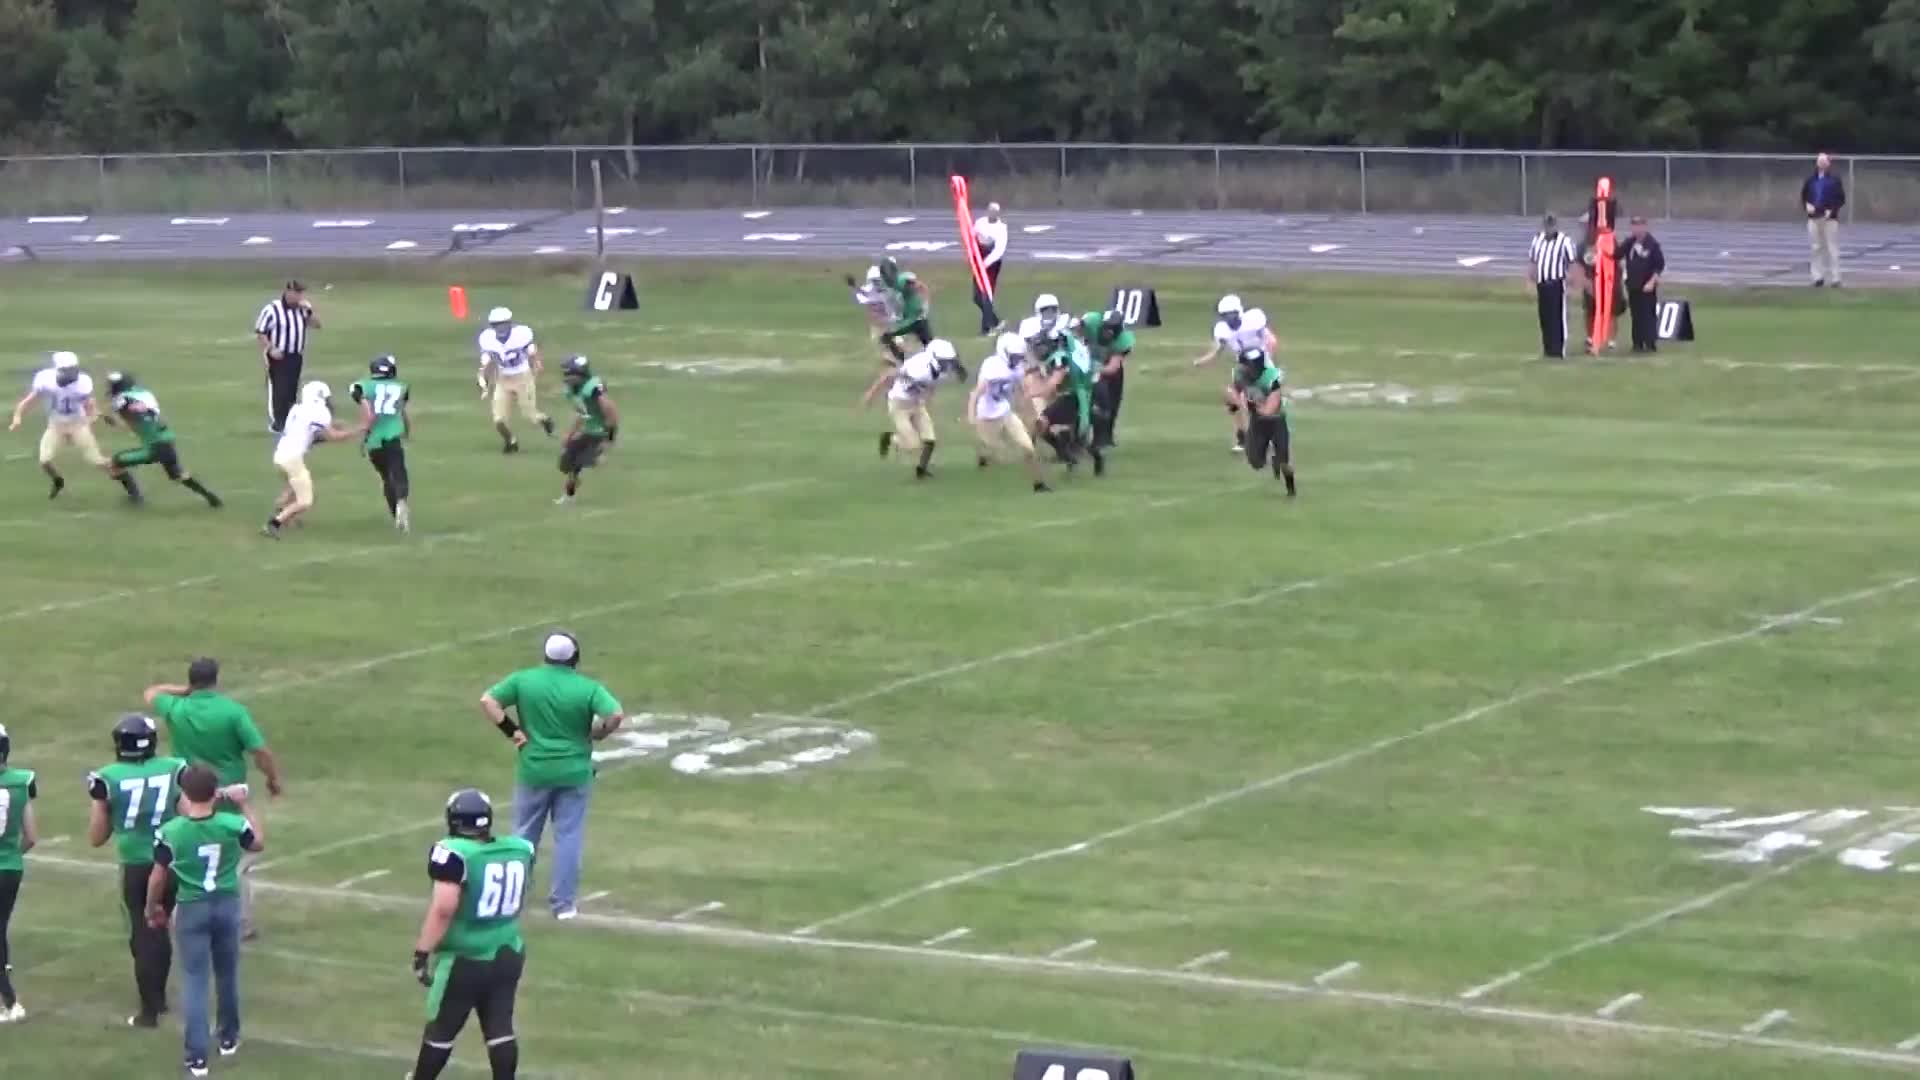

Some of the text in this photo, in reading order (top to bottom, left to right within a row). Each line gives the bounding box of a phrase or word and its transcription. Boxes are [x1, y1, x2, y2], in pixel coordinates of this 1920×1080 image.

[1656, 302, 1679, 338] 0
[374, 383, 401, 415] 12
[119, 773, 171, 829] 77
[197, 843, 222, 892] 7
[477, 860, 525, 918] 60
